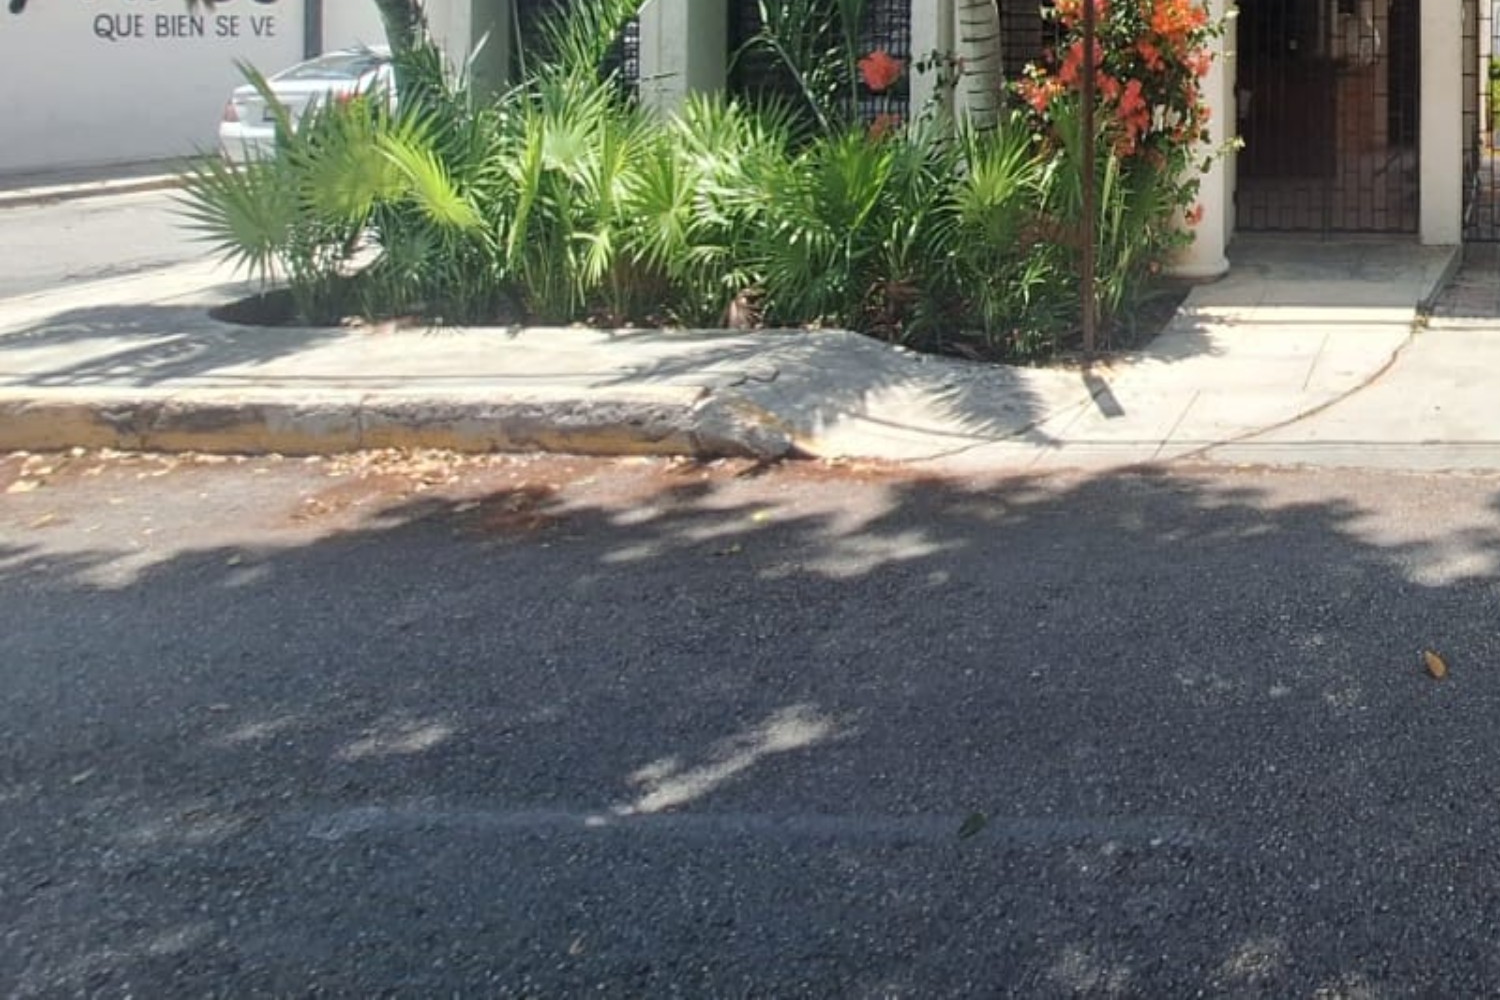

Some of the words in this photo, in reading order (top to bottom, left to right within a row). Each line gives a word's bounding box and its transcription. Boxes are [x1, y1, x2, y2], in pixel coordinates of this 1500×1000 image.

[93, 13, 143, 41] QUE
[155, 15, 204, 37] BIEN
[215, 16, 239, 37] SE
[250, 16, 275, 37] VE
